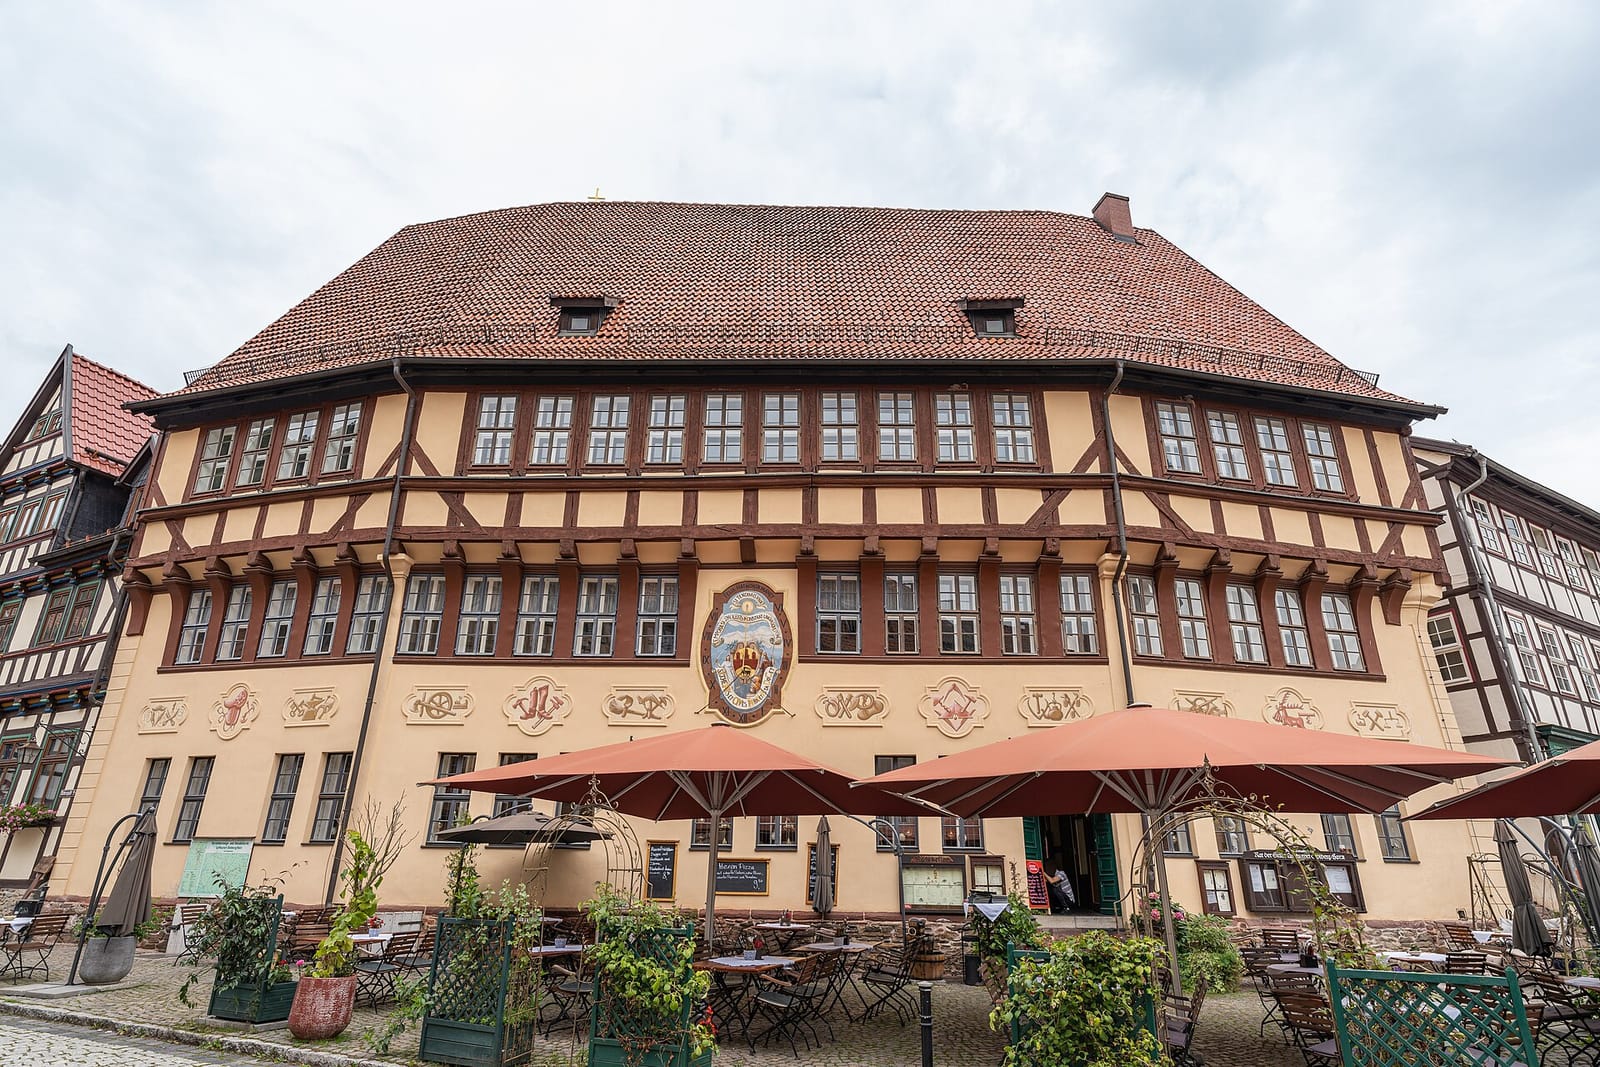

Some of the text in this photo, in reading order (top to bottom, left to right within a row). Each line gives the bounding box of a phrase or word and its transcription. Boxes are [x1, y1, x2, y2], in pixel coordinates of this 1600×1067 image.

[703, 656, 710, 664] IX
[710, 680, 716, 690] X
[739, 713, 748, 723] XII
